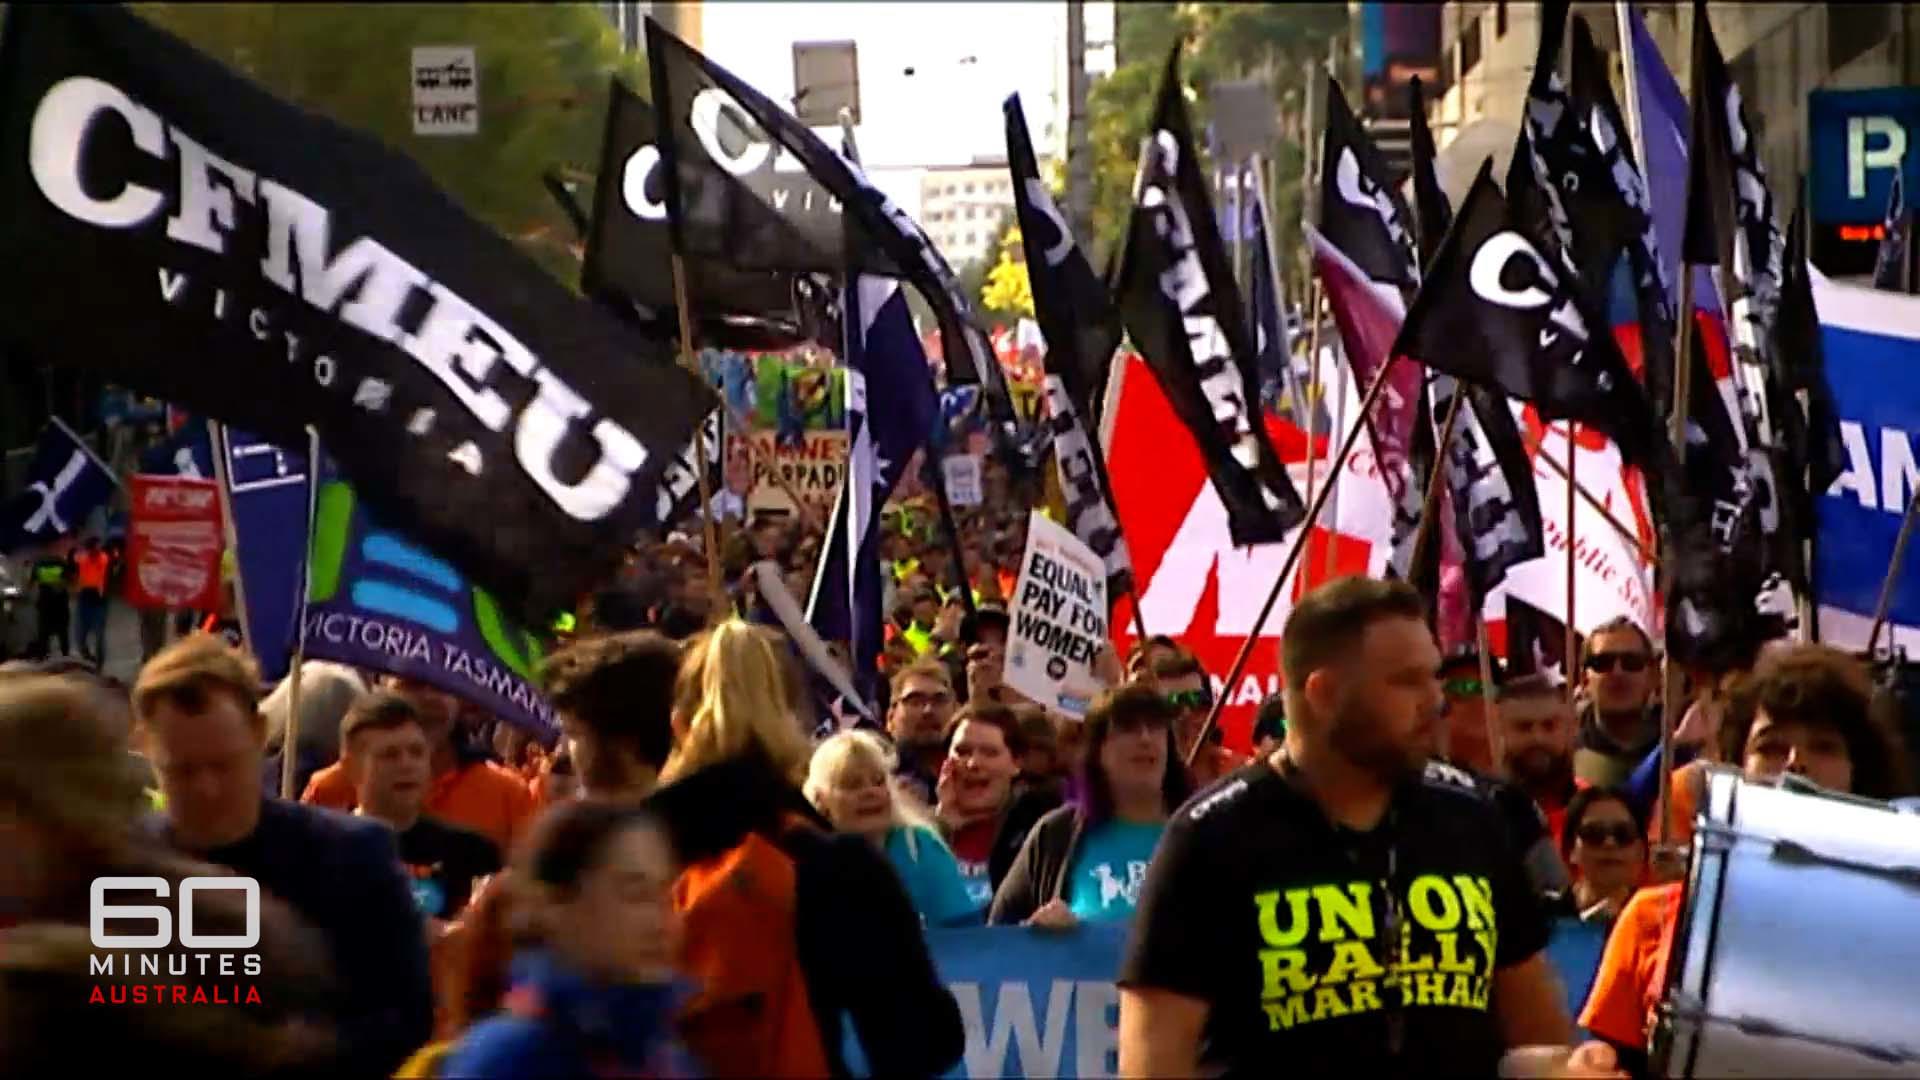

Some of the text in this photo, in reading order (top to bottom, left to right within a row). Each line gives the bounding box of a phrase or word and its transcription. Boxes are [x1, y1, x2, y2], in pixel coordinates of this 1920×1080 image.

[1847, 116, 1907, 199] P
[29, 75, 648, 521] CFMEU
[1021, 580, 1066, 620] PAY
[1029, 552, 1092, 604] EQUAL
[305, 612, 431, 662] VICTORIA
[1017, 611, 1103, 666] WOMEN
[1254, 874, 1496, 948] UNON
[1258, 928, 1498, 1000] RALLY
